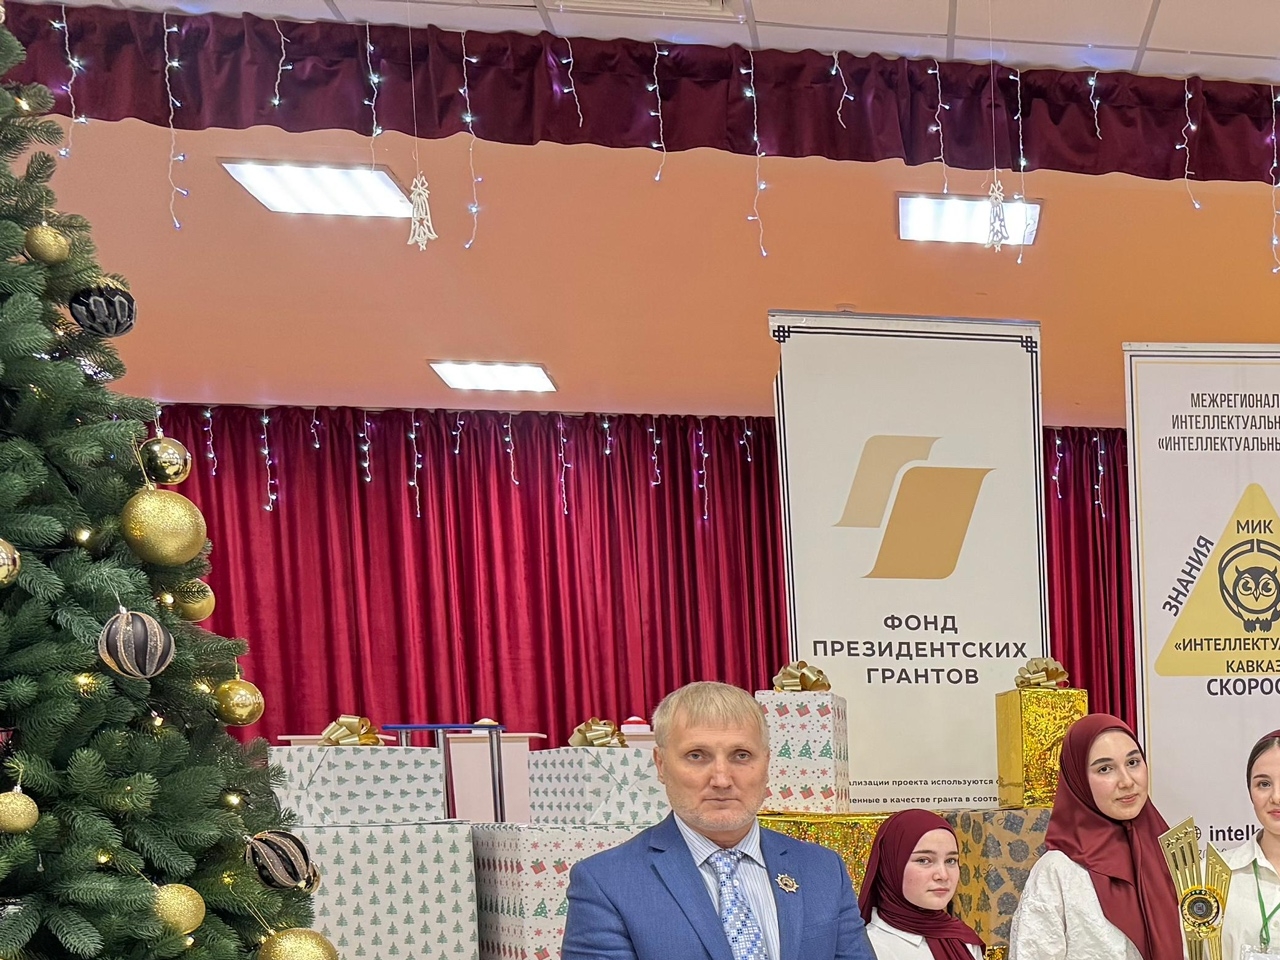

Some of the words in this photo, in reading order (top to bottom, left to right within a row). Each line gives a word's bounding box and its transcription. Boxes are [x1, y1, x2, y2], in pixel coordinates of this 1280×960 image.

[1236, 519, 1274, 534] МИК
[1162, 535, 1215, 617] ЗНАНИЯ
[883, 614, 958, 634] ФОНД
[812, 640, 1028, 661] ПРЕЗИДЕНТСКИХ
[867, 668, 980, 685] ГРАНТОВ
[892, 779, 929, 787] проекта
[931, 779, 994, 787] используются
[933, 796, 963, 804] гранта
